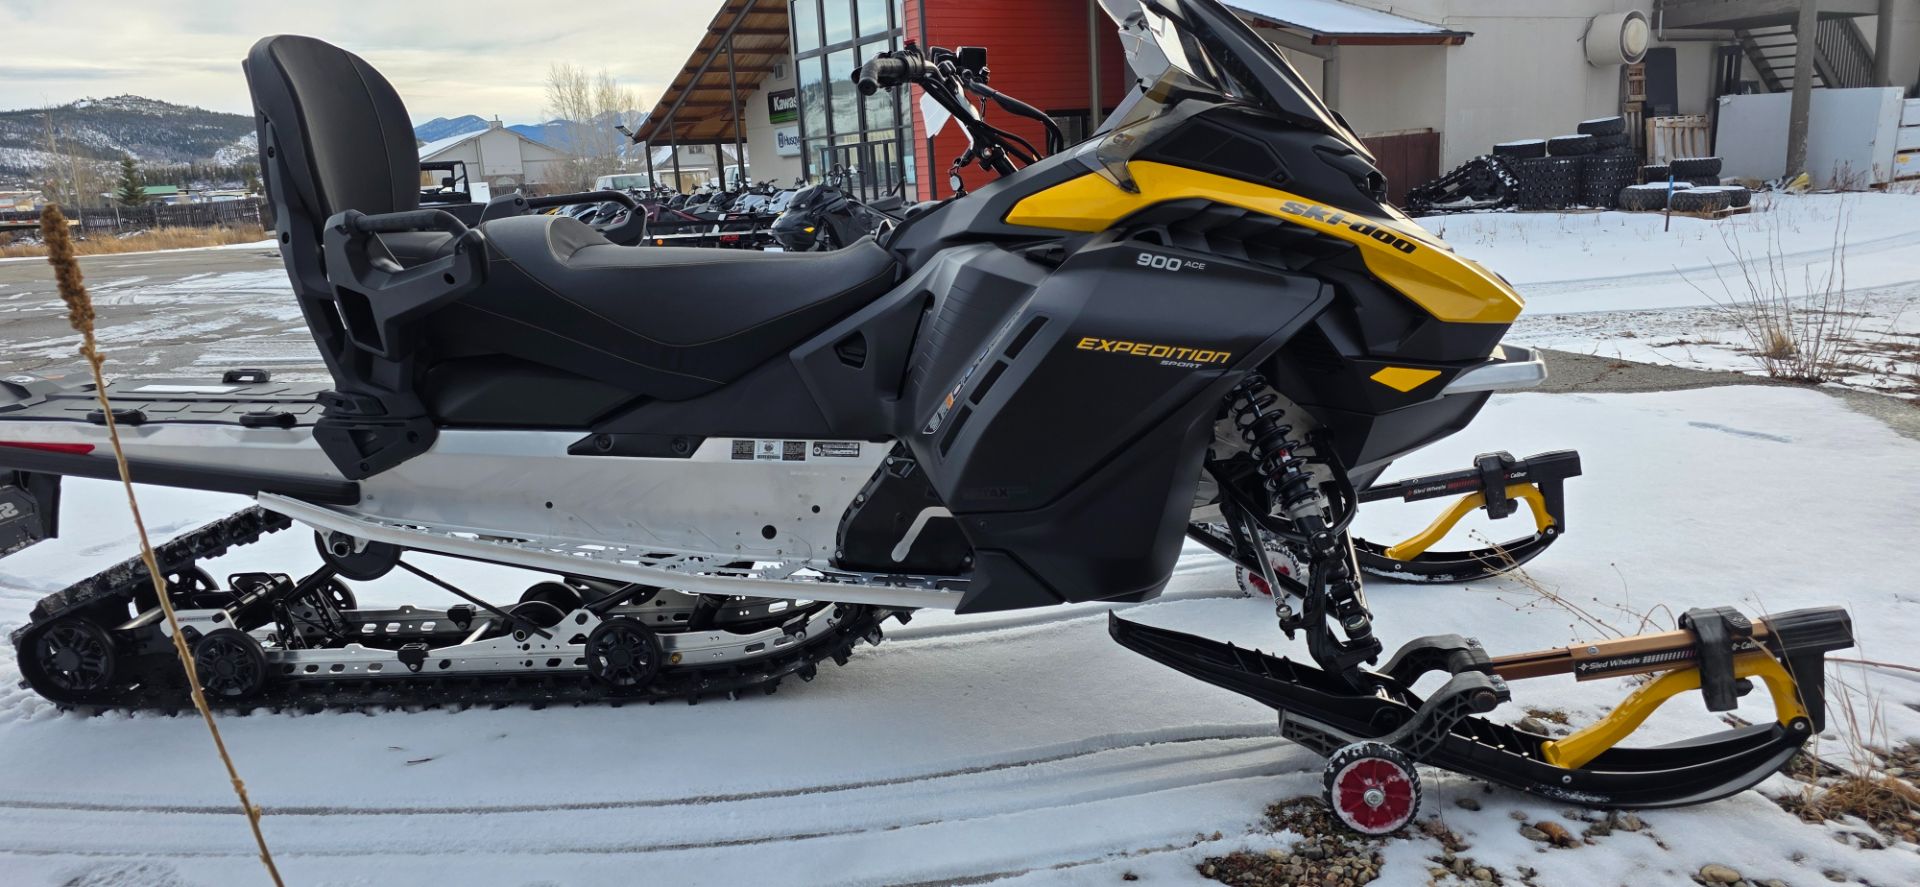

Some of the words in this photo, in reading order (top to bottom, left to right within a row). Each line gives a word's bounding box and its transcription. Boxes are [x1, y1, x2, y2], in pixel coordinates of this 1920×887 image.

[1136, 252, 1182, 271] 900
[1184, 260, 1206, 270] ACE
[1076, 337, 1232, 364] EXPEDITION
[1160, 360, 1202, 369] SPORT
[1589, 660, 1609, 670] Sled
[1610, 657, 1641, 668] Wheels
